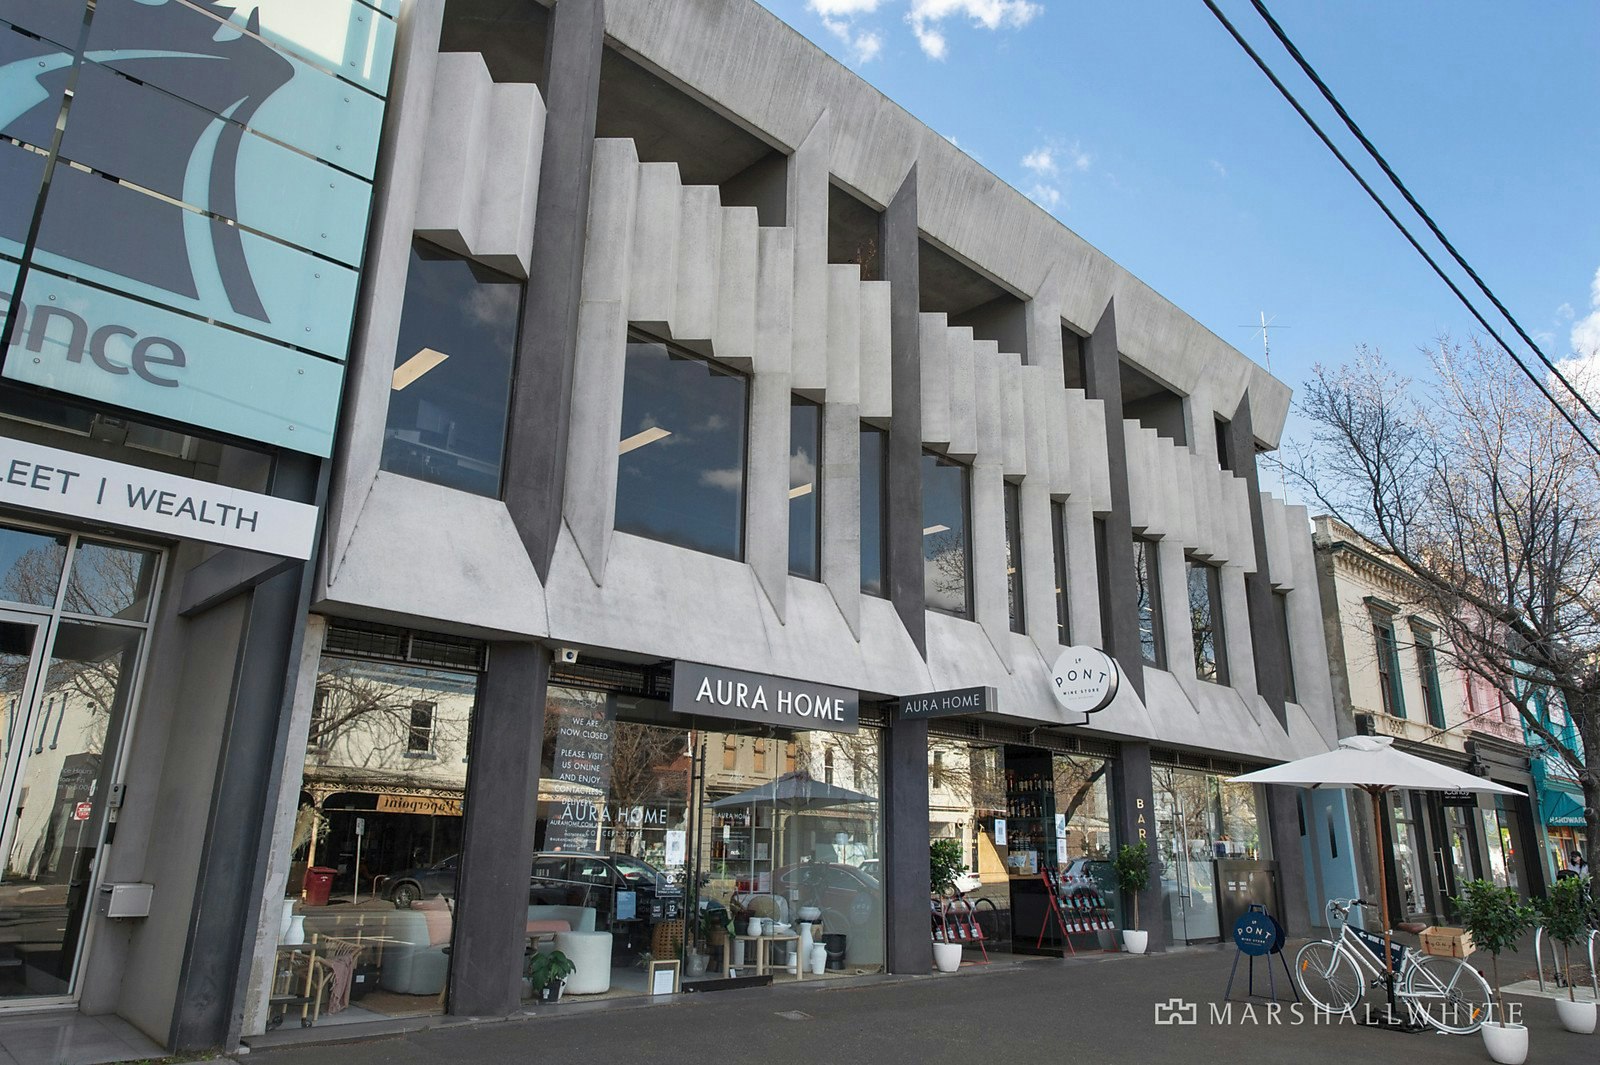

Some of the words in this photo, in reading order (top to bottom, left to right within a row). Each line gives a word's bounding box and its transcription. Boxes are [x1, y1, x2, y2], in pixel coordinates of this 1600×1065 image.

[0, 459, 80, 494] EET
[127, 484, 259, 532] WEALTH
[1055, 668, 1107, 688] PONT
[695, 676, 768, 711] AURA
[777, 689, 844, 721] HOME
[904, 698, 938, 713] AURA
[942, 693, 980, 709] HOME
[572, 717, 584, 726] WE
[586, 719, 599, 728] ARE
[560, 727, 580, 737] NOW
[582, 730, 608, 740] CLOSED
[561, 749, 586, 759] PLEASE
[587, 751, 604, 760] VISIT
[561, 761, 572, 769] US
[573, 762, 600, 772] ONLINE
[560, 773, 577, 781] AND
[578, 774, 601, 784] ENJOY
[554, 784, 603, 796] CONTACTLESS
[561, 802, 611, 822] AURA
[618, 807, 667, 824] HOME
[1136, 798, 1147, 839] BAR
[1237, 926, 1271, 939] PONT
